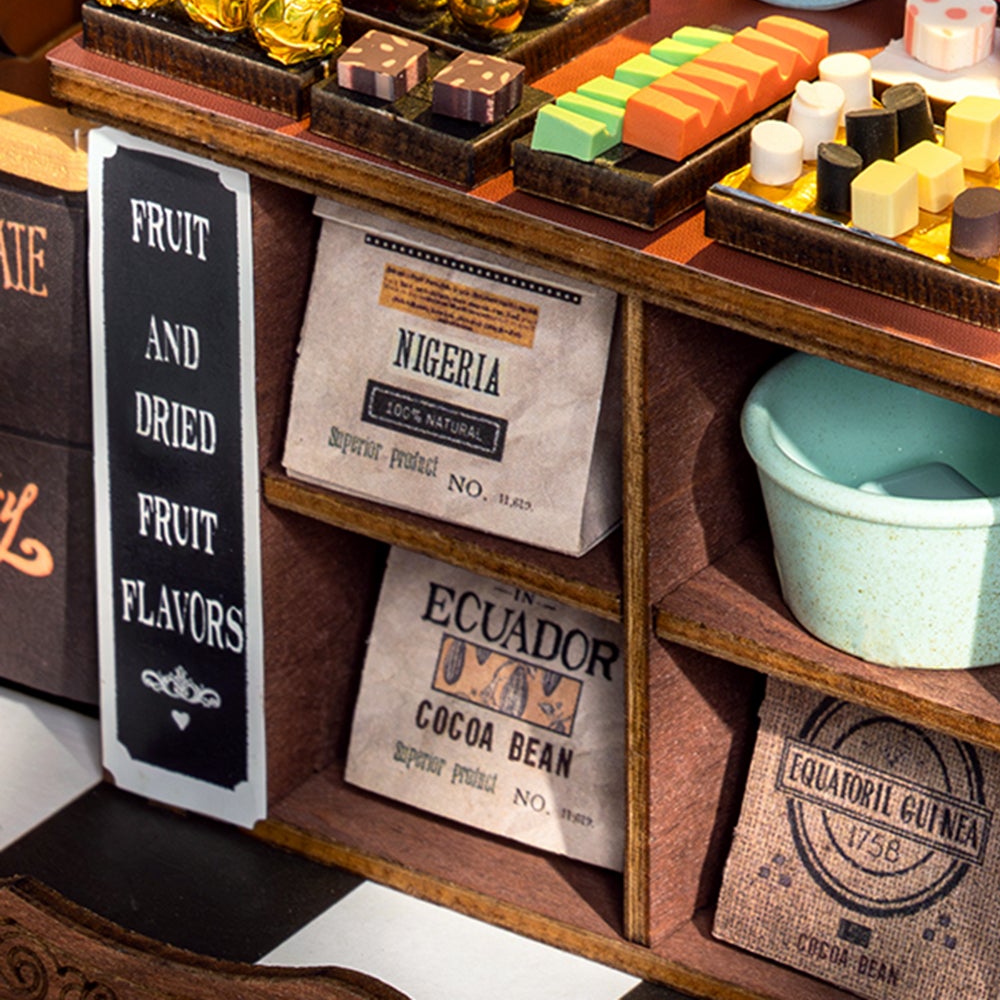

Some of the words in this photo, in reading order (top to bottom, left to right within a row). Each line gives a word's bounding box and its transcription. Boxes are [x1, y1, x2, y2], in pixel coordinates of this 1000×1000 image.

[131, 198, 210, 262] FRUIT
[144, 316, 200, 371] AND
[393, 328, 501, 397] NIGERIA
[135, 391, 217, 455] DRIED
[328, 426, 383, 461] Superior
[426, 412, 484, 443] NATURAL
[447, 473, 488, 502] NO.
[138, 492, 218, 556] FRUIT
[121, 577, 245, 655] FLAVORS
[421, 582, 620, 682] ECUADOR
[414, 699, 494, 752] COCOA
[508, 731, 574, 779] BEAN
[513, 787, 550, 816] NO.
[789, 754, 893, 818] EQUATORIL
[900, 794, 979, 850] GUINEA
[847, 826, 901, 864] 1758
[797, 933, 849, 968] COCOA
[857, 954, 900, 987] BEAN
